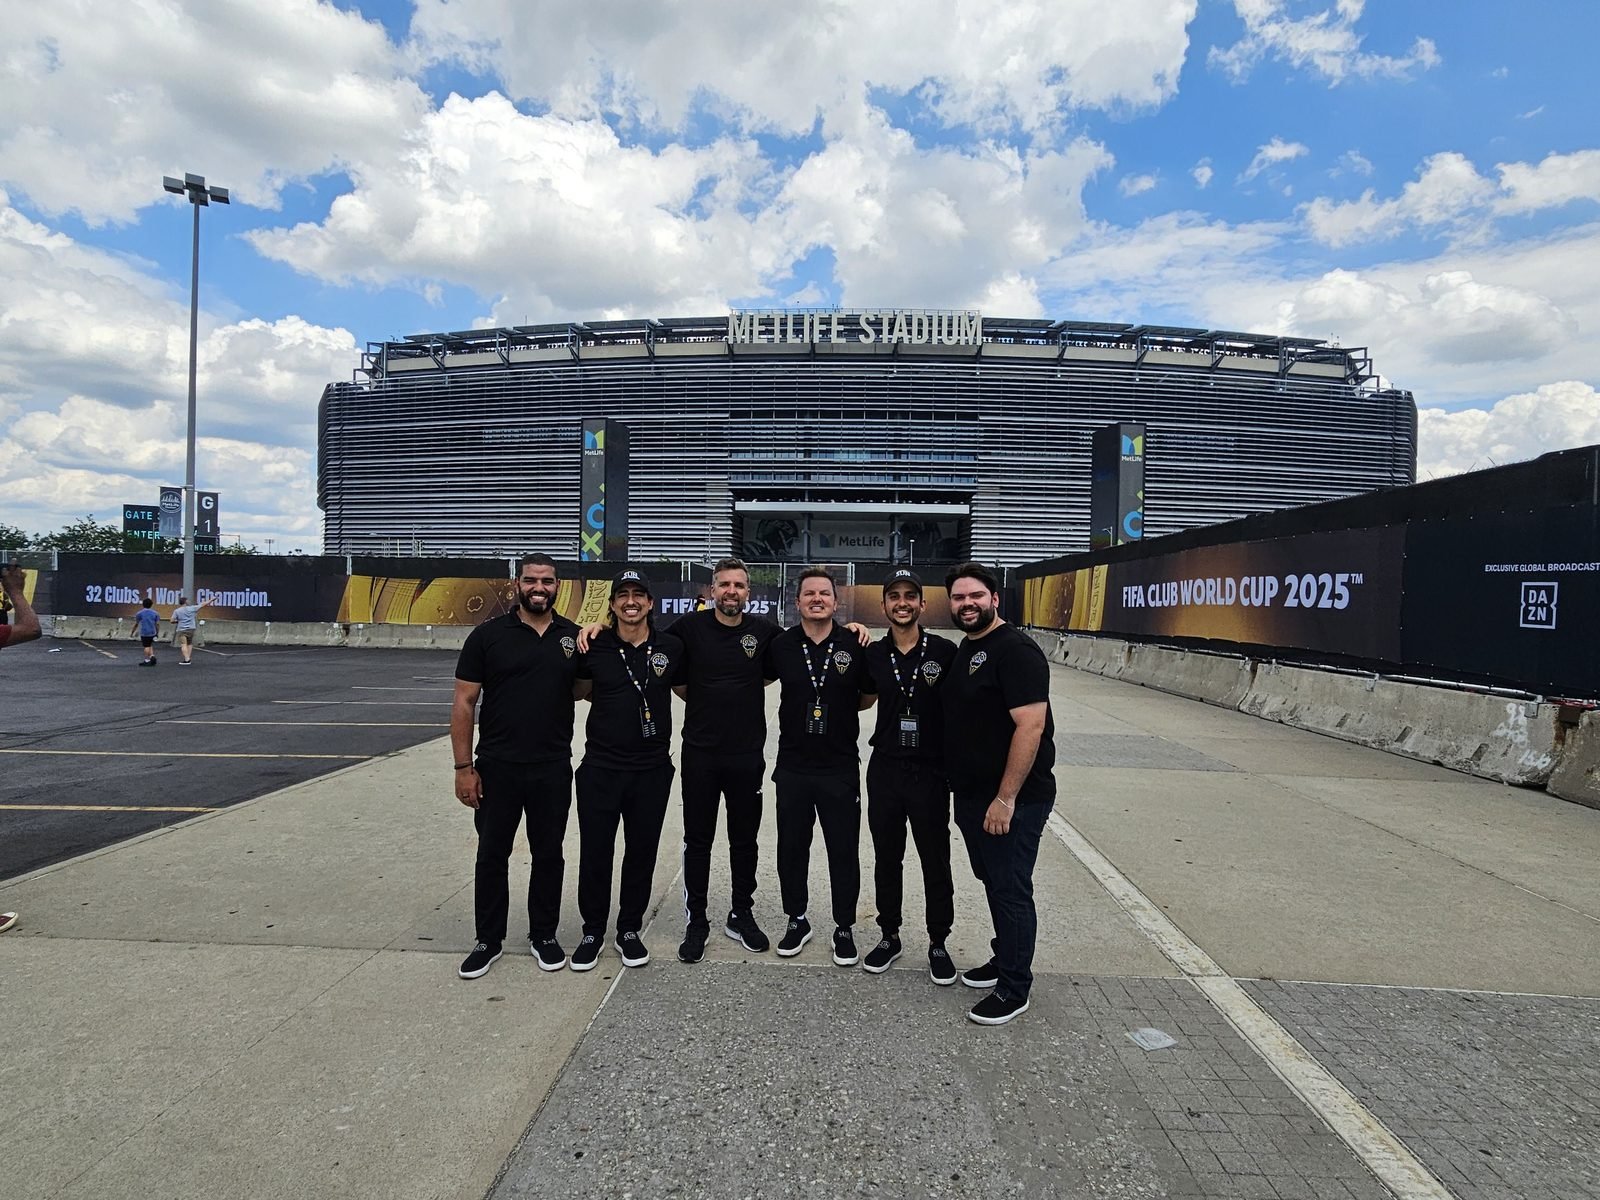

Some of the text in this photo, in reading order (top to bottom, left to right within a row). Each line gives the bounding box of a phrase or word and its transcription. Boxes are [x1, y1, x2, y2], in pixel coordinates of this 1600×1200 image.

[728, 312, 983, 346] METLIFE STADIUM
[201, 496, 214, 510] G
[125, 511, 153, 520] GATE
[204, 520, 211, 533] 1
[194, 544, 214, 552] NTER
[838, 536, 885, 547] MetLife
[1485, 564, 1519, 572] EXCLUSIVE
[1520, 564, 1546, 572] GLOBAL
[86, 585, 102, 603] 32
[104, 586, 143, 605] Clubs.
[196, 587, 272, 608] Champion.
[1122, 586, 1145, 608] FIFA
[1147, 581, 1178, 607] CLUB
[1180, 577, 1236, 606] WORLD
[1239, 576, 1279, 607] CUP
